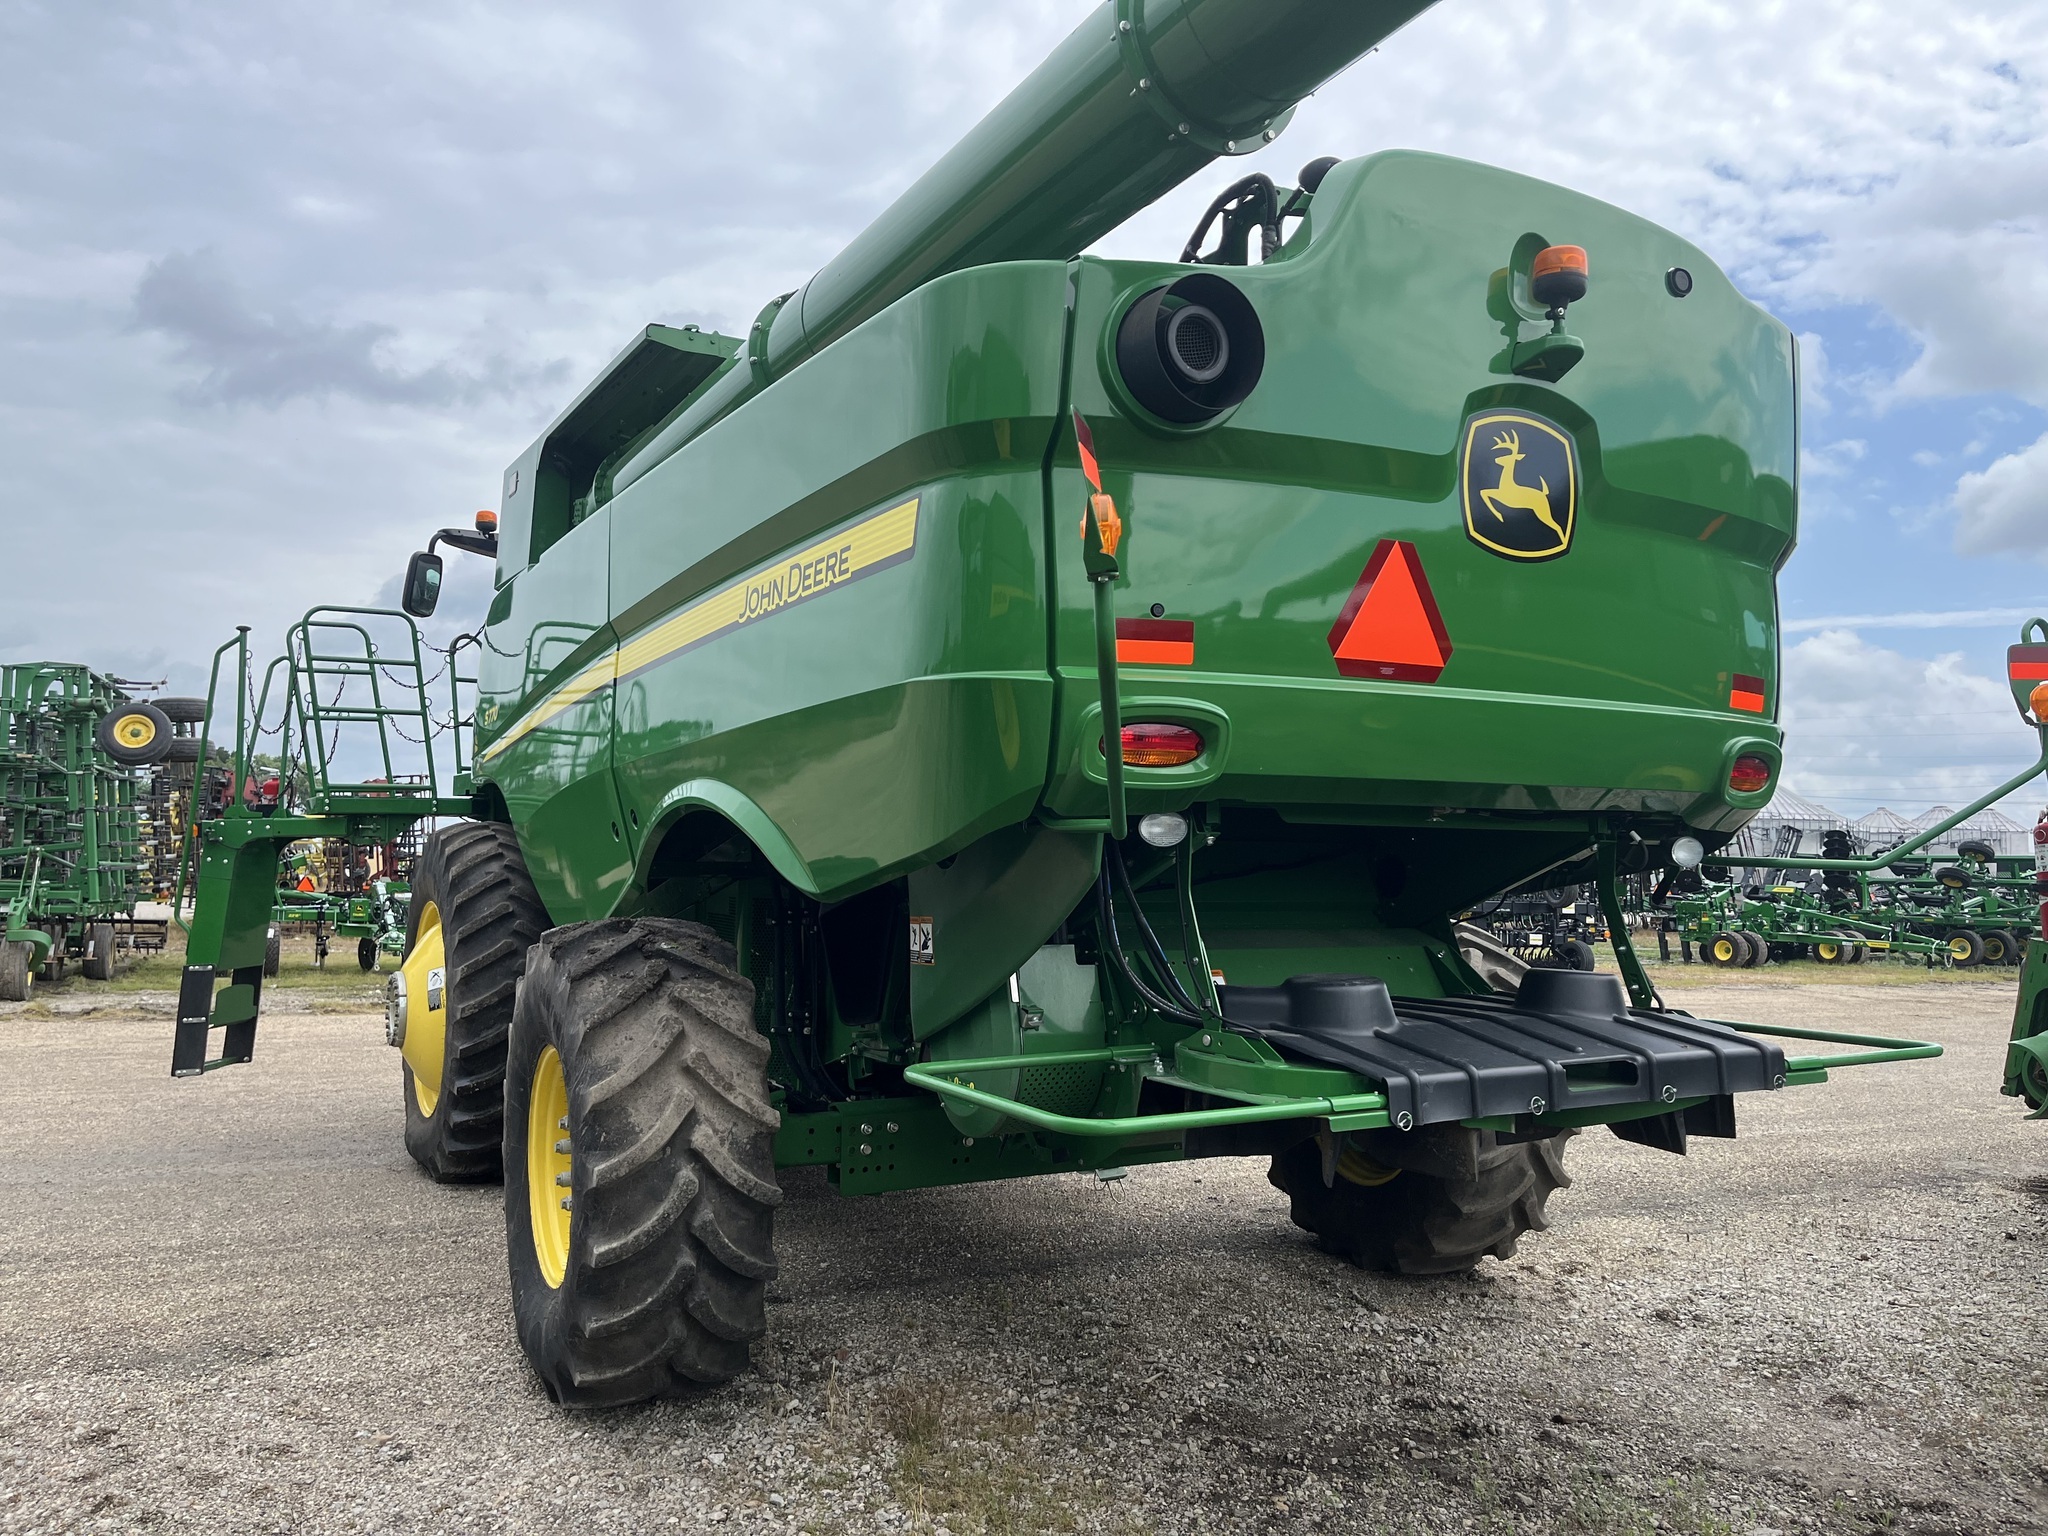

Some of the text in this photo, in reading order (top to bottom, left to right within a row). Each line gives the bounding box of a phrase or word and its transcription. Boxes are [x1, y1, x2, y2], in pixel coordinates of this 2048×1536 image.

[738, 545, 851, 620] JOHN DEERE
[484, 704, 499, 726] S770
